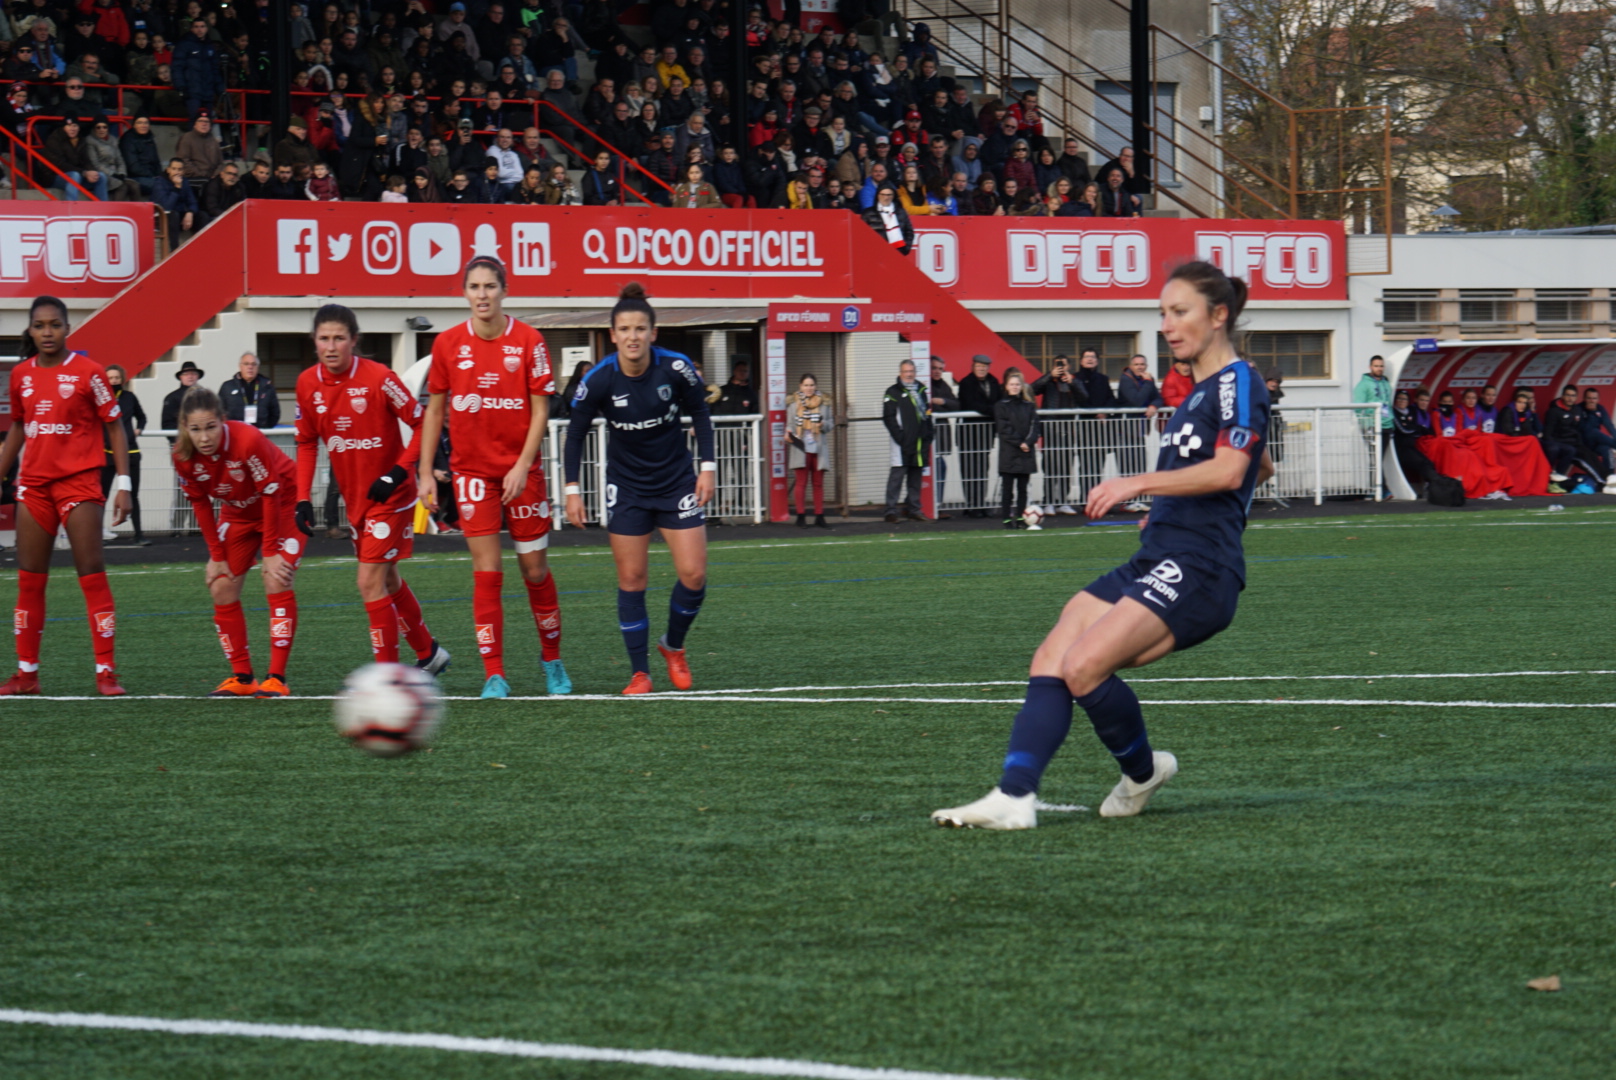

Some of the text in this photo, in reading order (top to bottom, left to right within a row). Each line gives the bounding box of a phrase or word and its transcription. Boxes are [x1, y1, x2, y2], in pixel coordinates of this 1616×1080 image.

[615, 227, 824, 267] DFCO OFFICIEL
[1006, 229, 1150, 288] DFCO
[1195, 231, 1331, 289] DFCO
[776, 312, 799, 322] DFCO
[871, 313, 894, 323] DFCO
[482, 397, 524, 410] suez
[1218, 384, 1235, 421] AÉSIO
[39, 423, 73, 435] suez
[611, 417, 663, 431] VINCI
[344, 436, 383, 450] suez
[456, 476, 486, 503] 10
[510, 502, 542, 519] LDS
